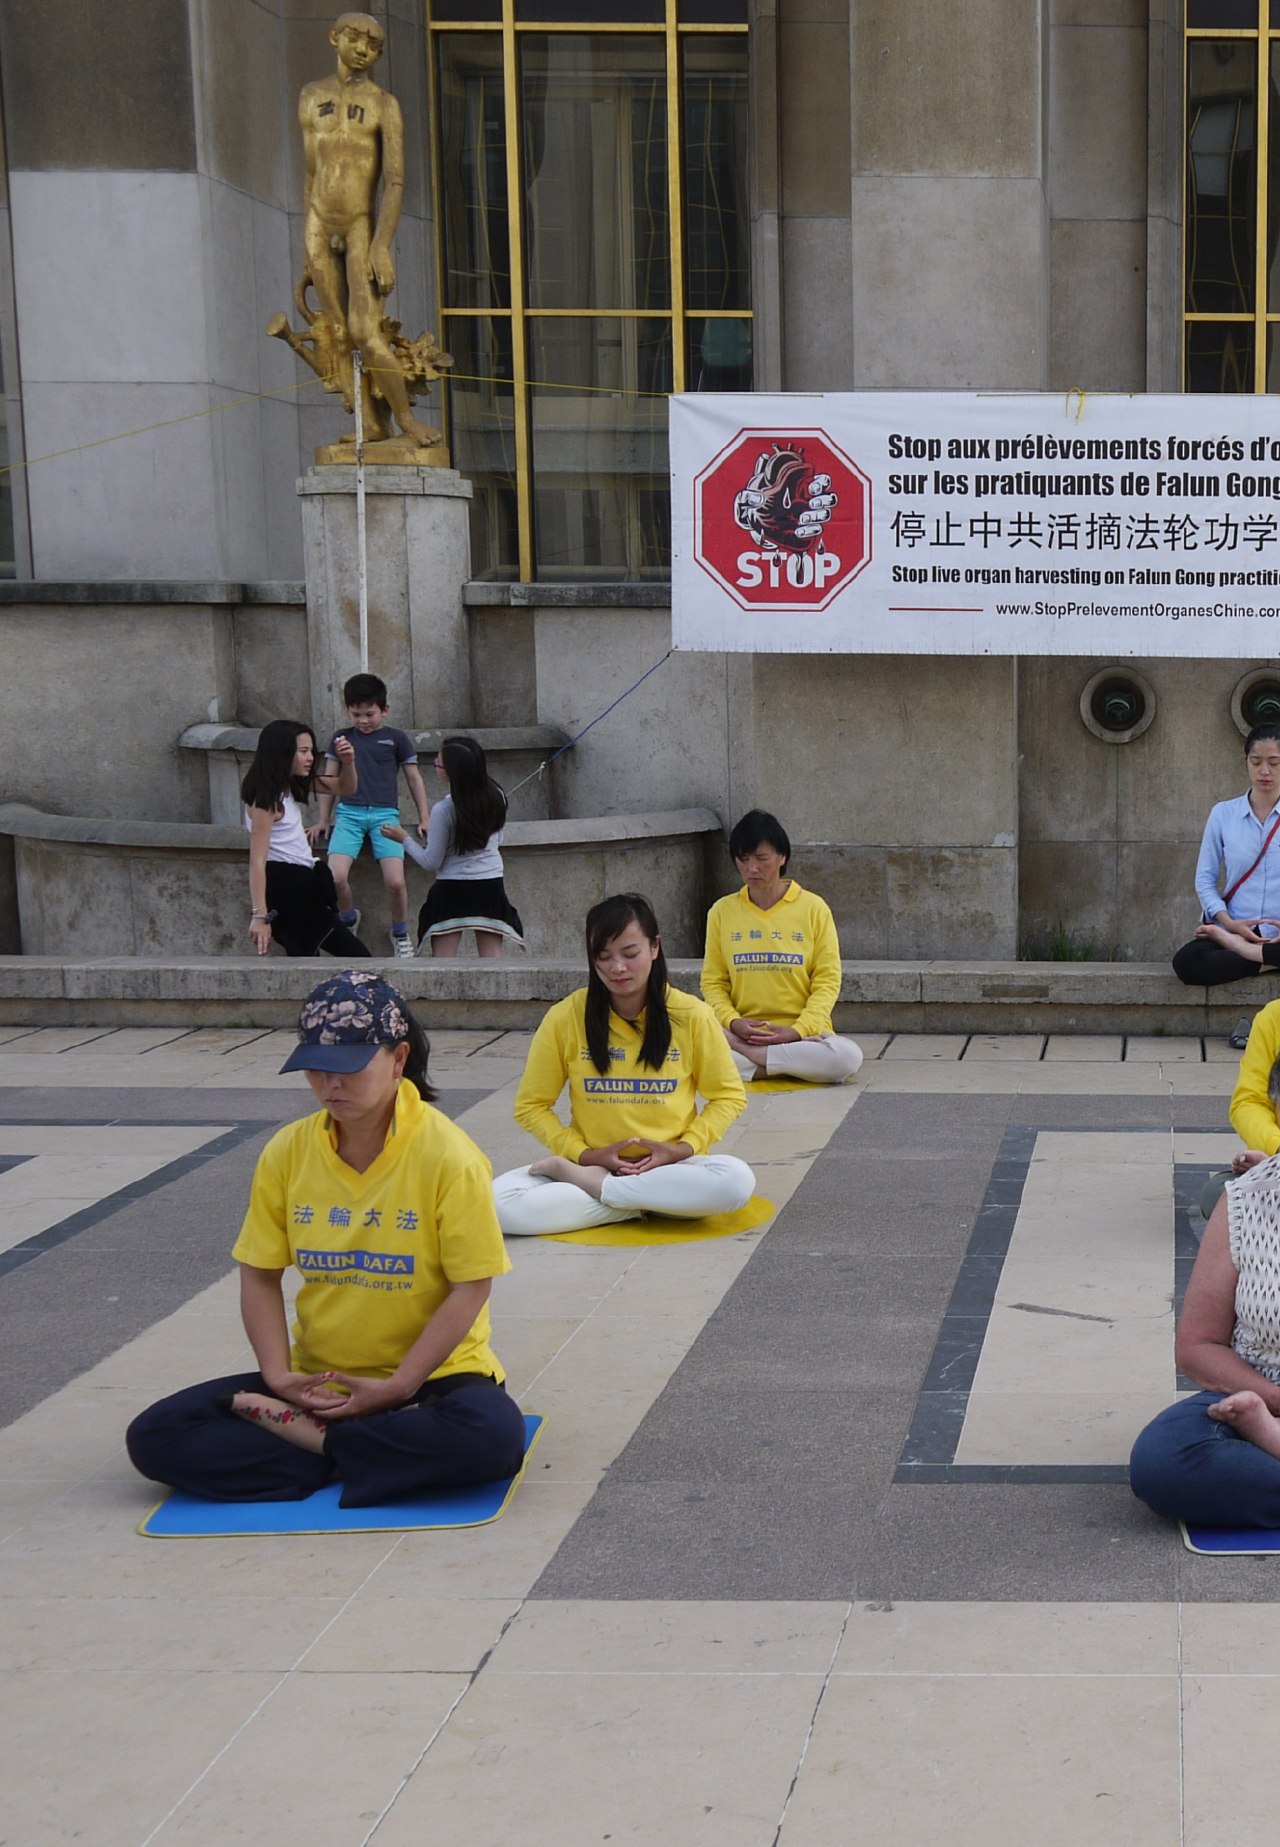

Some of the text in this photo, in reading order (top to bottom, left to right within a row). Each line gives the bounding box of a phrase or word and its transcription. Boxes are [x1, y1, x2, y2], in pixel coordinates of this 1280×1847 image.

[888, 433, 941, 461] Stop
[947, 436, 990, 460] aux
[995, 433, 1162, 462] prélèvements
[1167, 435, 1244, 461] forcés
[888, 473, 928, 495] sur
[934, 470, 969, 495] les
[974, 471, 1114, 498] pratiquants
[1120, 472, 1150, 496] de
[1156, 472, 1220, 497] Falun
[735, 551, 841, 588] STOP
[892, 565, 928, 584] Stop
[932, 565, 960, 583] live
[964, 568, 1011, 585] organ
[1015, 566, 1101, 586] harvesting
[1104, 569, 1124, 585] on
[1129, 568, 1171, 585] Falun
[1175, 568, 1215, 587] Gong
[735, 954, 801, 964] FALUN DAFA
[586, 1081, 674, 1092] FALUN DAFA
[293, 1204, 419, 1231] 法輪大法
[300, 1254, 408, 1272] FALUN DAFA
